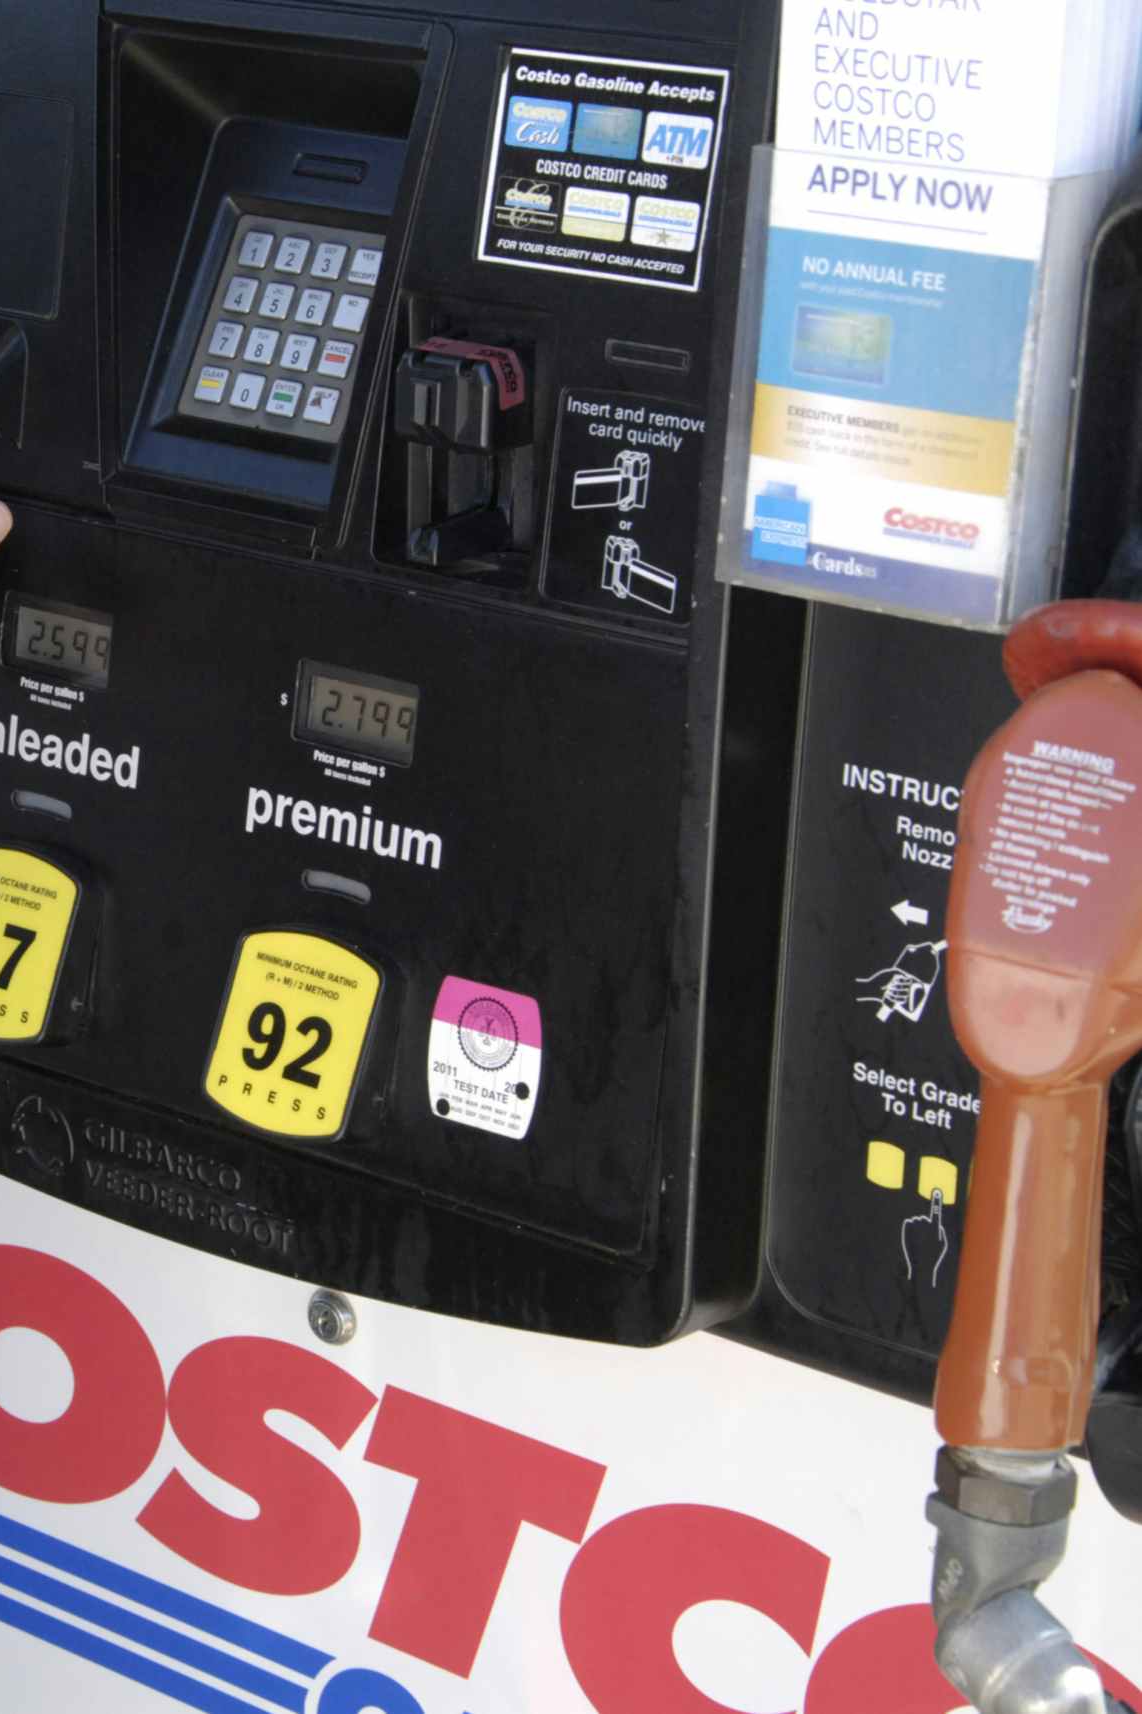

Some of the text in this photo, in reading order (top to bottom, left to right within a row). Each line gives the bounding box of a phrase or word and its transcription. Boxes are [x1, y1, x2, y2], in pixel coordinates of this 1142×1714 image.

[814, 7, 879, 41] AND
[814, 43, 983, 90] EXECUTIVE
[515, 65, 716, 104] Costco Gasoline Accepts
[813, 80, 936, 123] COSTCO
[515, 122, 562, 146] Cash
[646, 124, 709, 158] ATM
[813, 117, 966, 163] MEMBERS
[536, 159, 669, 190] COSTCO CREDIT CARDS
[807, 164, 993, 214] APPLY NOW
[251, 247, 258, 260] 1
[284, 253, 295, 266] 2
[322, 259, 331, 273] 3
[497, 238, 686, 275] FOR YOUR SECURITY NO CASH ACCEPTED
[802, 255, 947, 292] NO ANNUAL FEE
[234, 293, 243, 306] 4
[269, 299, 280, 313] 5
[305, 305, 315, 319] 6
[219, 337, 229, 351] 7
[254, 343, 264, 358] 8
[291, 350, 300, 365] 9
[240, 388, 250, 402] 0
[567, 396, 611, 419] Insert
[614, 407, 645, 424] and
[787, 405, 900, 433] EXECUTIVE MEMBERS
[588, 421, 683, 452] card quickly
[619, 518, 633, 530] or
[812, 551, 864, 577] Cards
[40, 682, 53, 694] per
[314, 749, 335, 765] Price
[336, 757, 350, 768] per
[352, 761, 378, 775] gallon
[1034, 740, 1115, 776] WARNING
[842, 762, 965, 811] INSTRUC
[245, 786, 442, 870] premium
[896, 815, 957, 846] Remo
[902, 840, 953, 870] Nozz
[0, 877, 28, 891] OCTANE
[30, 884, 57, 899] RATING
[10, 896, 41, 911] METHOD
[293, 963, 325, 979] OCTANE
[328, 973, 358, 989] RATING
[305, 983, 339, 1000] METHOD
[242, 1002, 333, 1089] 92
[433, 1061, 457, 1076] 2011
[218, 1075, 326, 1120] PRESS
[453, 1079, 509, 1104] TEST DATE
[853, 1062, 980, 1114] Select Grade
[881, 1093, 953, 1130] To Left
[83, 1120, 242, 1192] GILBARCO
